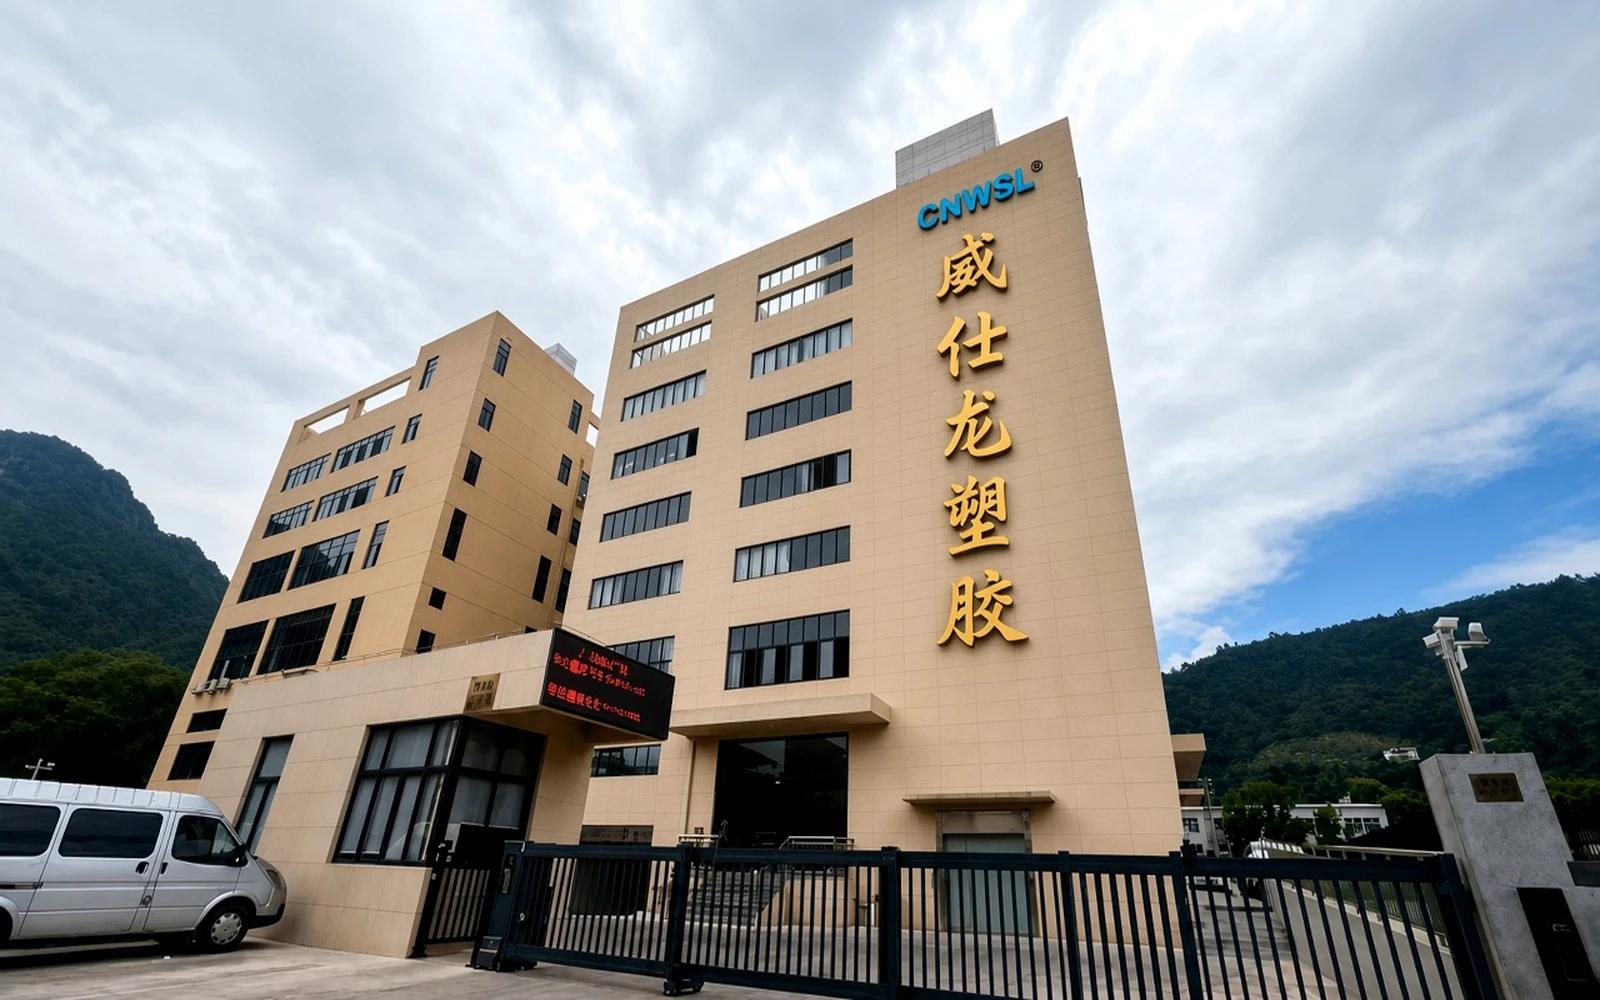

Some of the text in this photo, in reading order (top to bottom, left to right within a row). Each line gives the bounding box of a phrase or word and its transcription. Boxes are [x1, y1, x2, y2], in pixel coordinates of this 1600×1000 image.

[917, 167, 1036, 230] CNWSL
[936, 231, 1029, 648] 威仕龙塑胶
